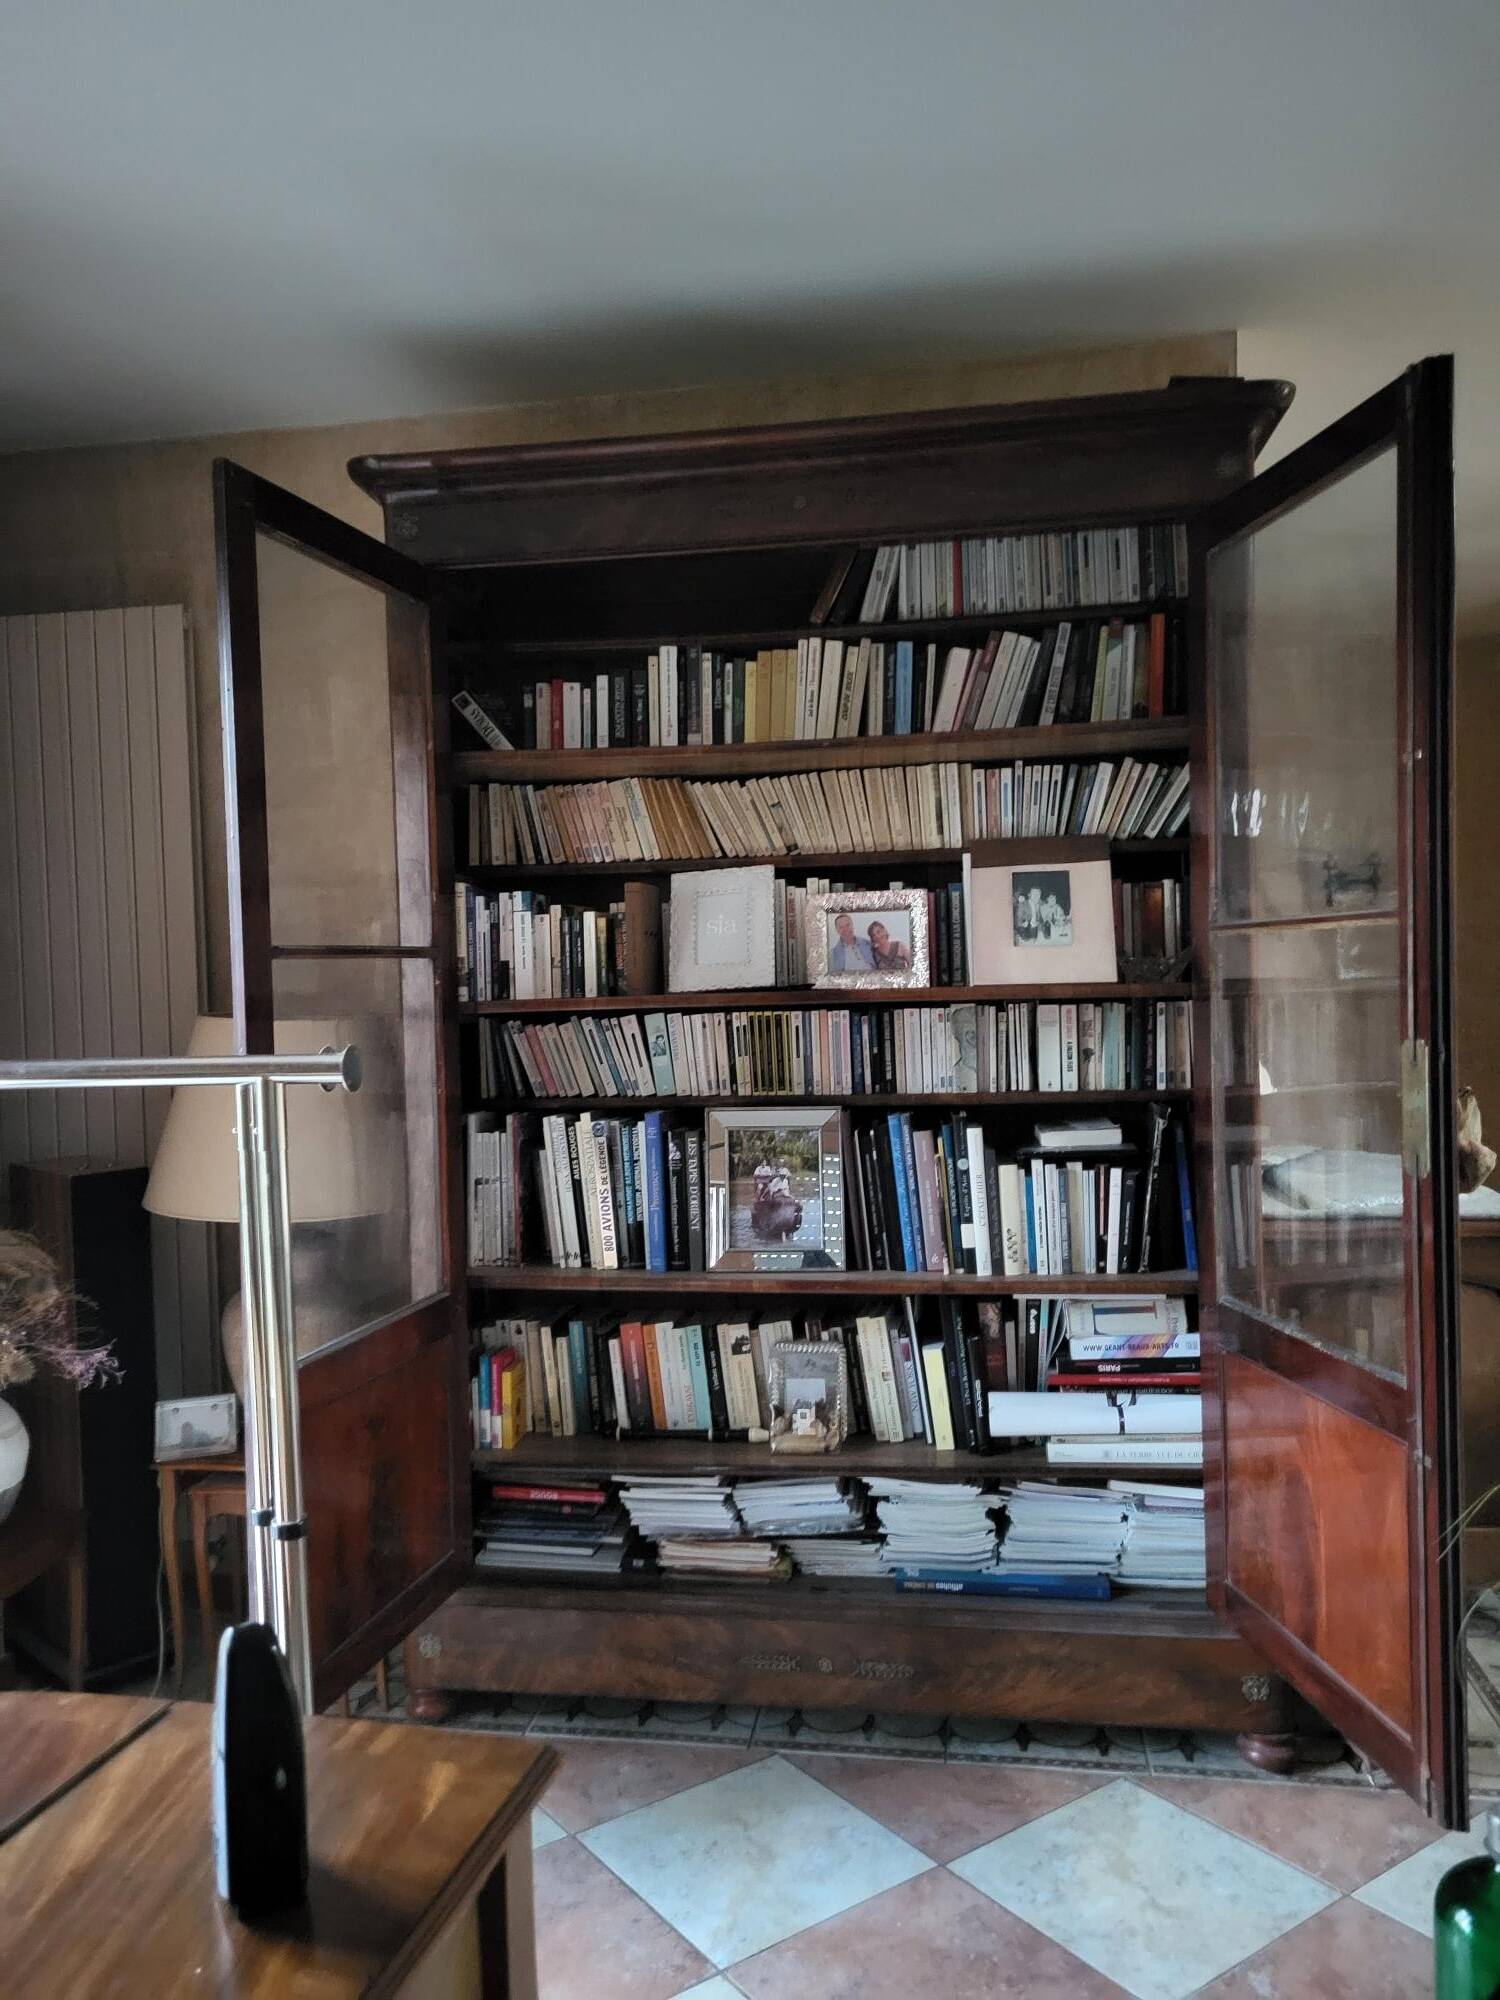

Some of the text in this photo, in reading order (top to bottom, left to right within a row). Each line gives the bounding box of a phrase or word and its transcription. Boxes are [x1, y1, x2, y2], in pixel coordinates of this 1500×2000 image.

[567, 1125, 581, 1180] AILES ROUGES
[601, 1175, 608, 1185] DE
[688, 1136, 700, 1231] LES TAPIS D'ORIENT
[599, 1188, 613, 1231] AVIONS
[605, 1235, 615, 1252] 800
[1097, 1364, 1120, 1372] PARIS
